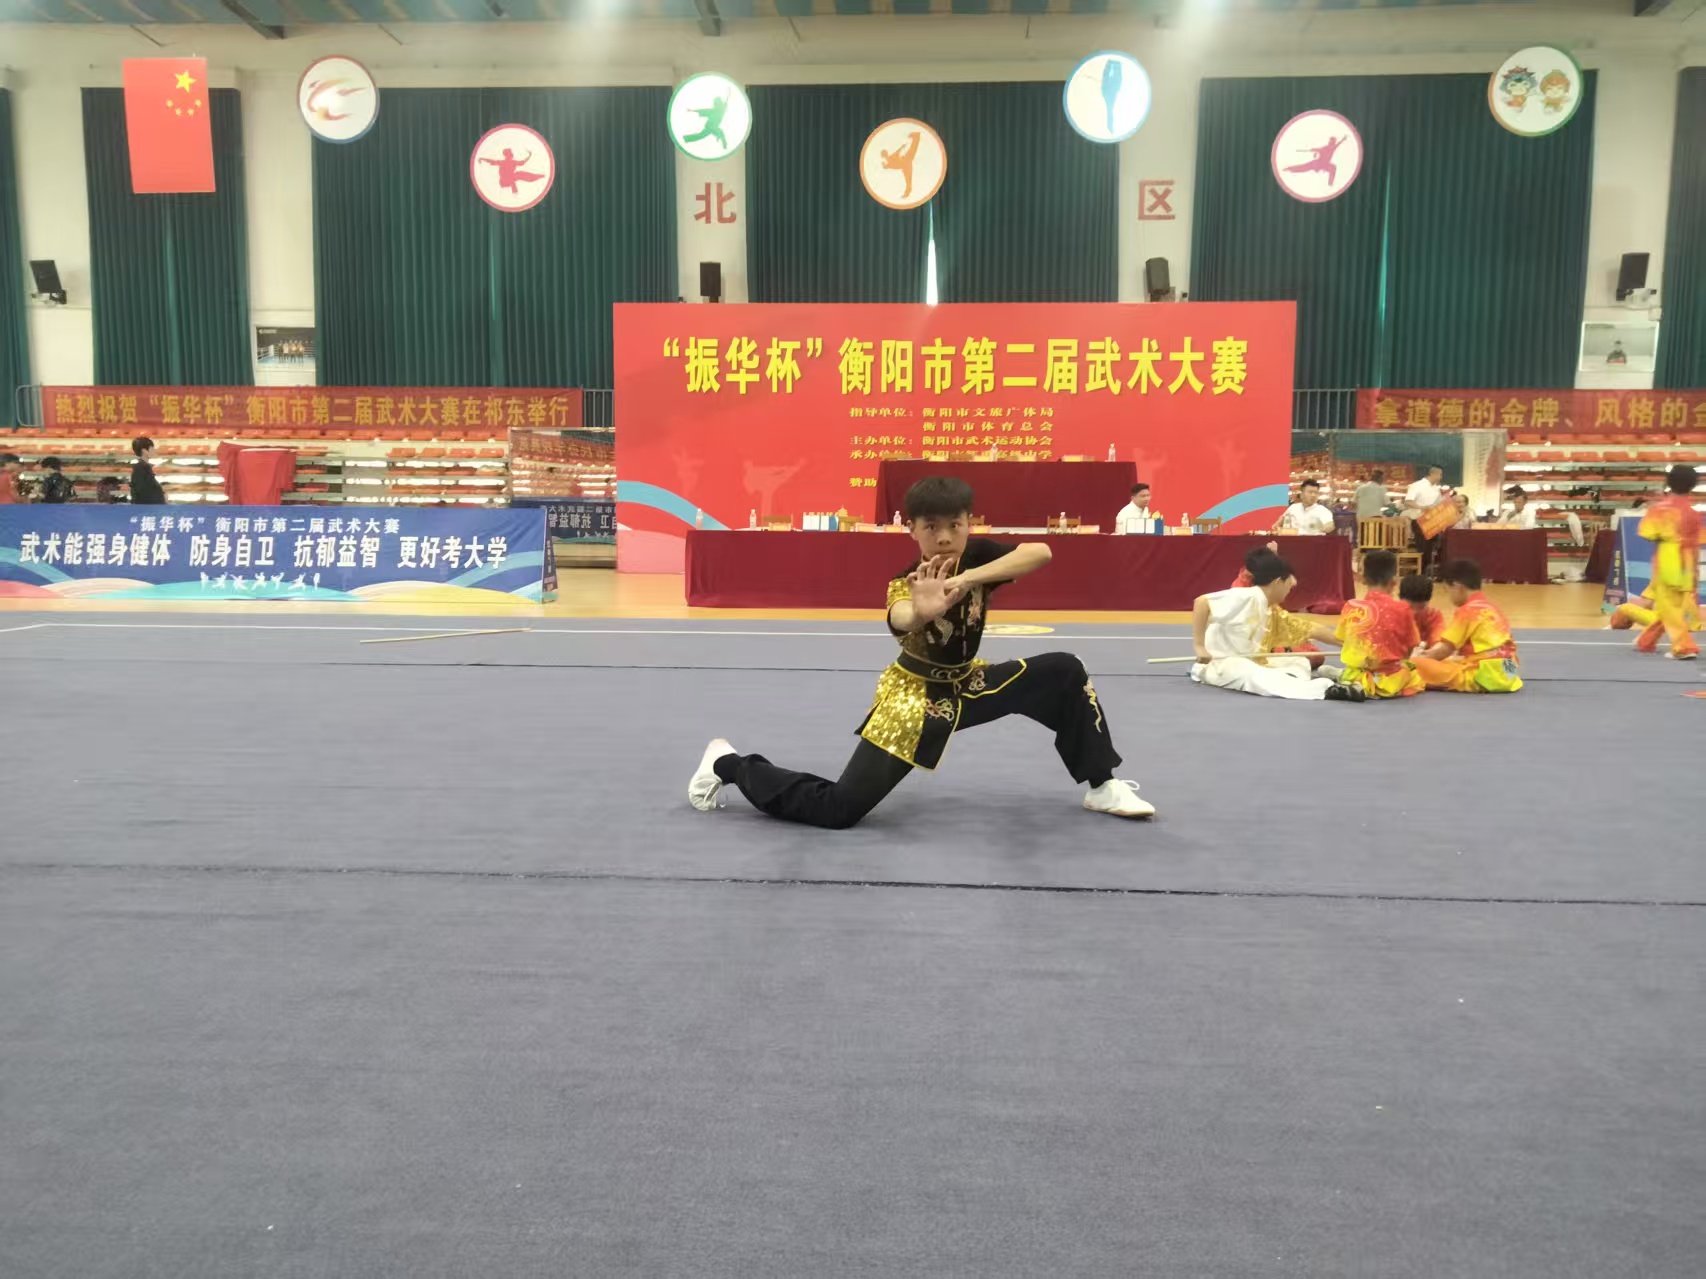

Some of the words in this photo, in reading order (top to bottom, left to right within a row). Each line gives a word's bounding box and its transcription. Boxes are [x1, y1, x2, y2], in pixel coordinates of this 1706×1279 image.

[694, 182, 737, 224] 北
[1138, 180, 1175, 220] 区
[663, 336, 1248, 395] “振华杯”衡阳市第二届武术大赛
[130, 515, 400, 535] “振华杯”衡阳市第二届武术大赛
[19, 531, 172, 567] 武术能强身健体
[189, 534, 275, 567] 防身自卫
[293, 534, 381, 568] 抗郁益智
[397, 536, 508, 569] 更好考大学
